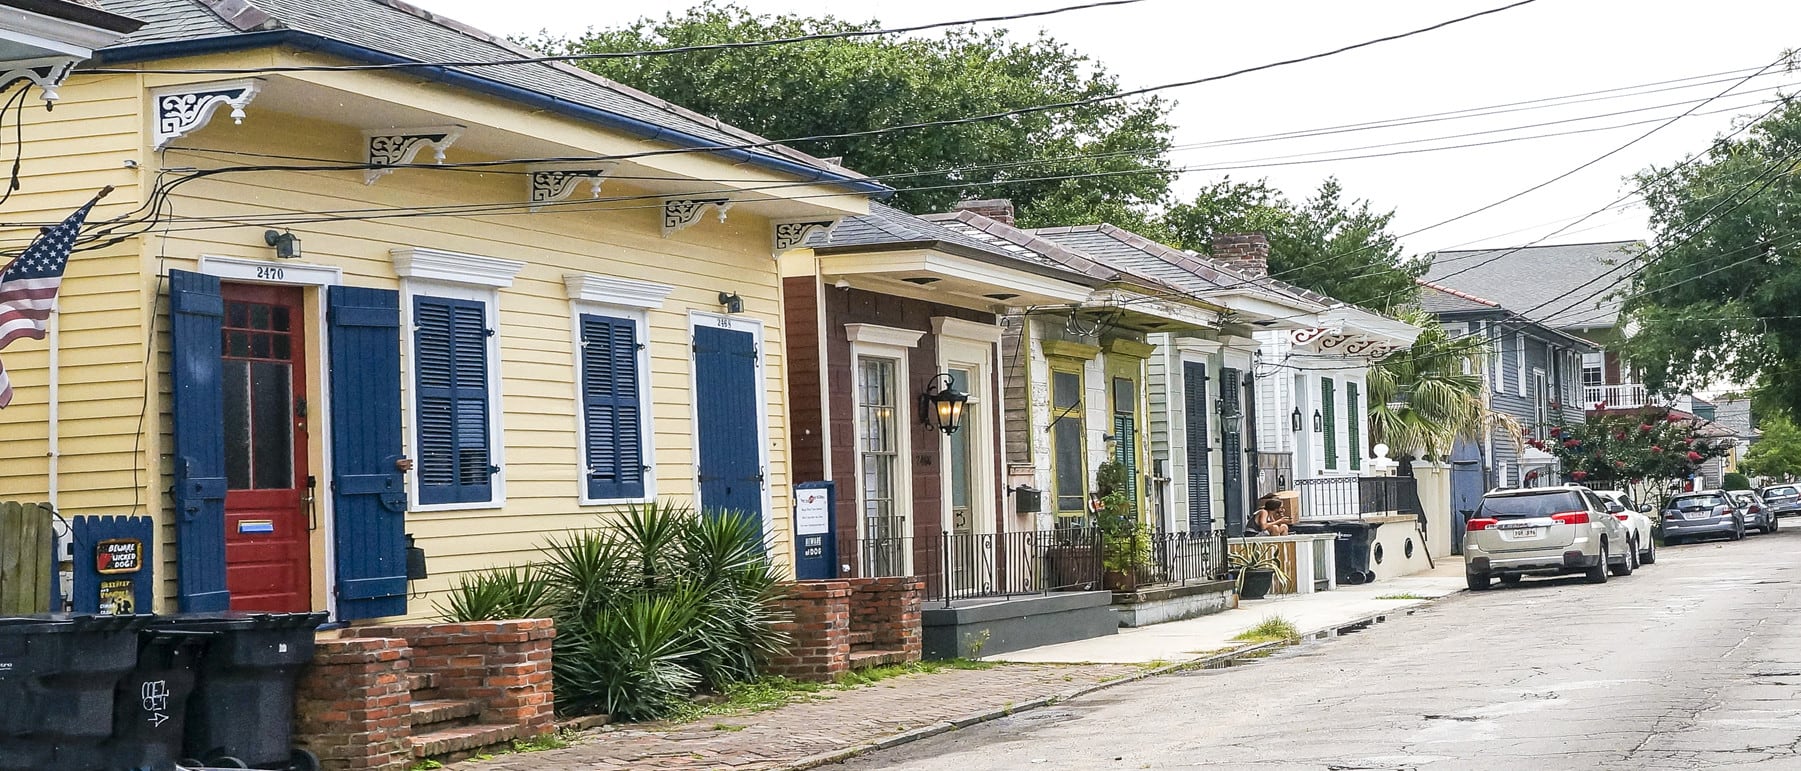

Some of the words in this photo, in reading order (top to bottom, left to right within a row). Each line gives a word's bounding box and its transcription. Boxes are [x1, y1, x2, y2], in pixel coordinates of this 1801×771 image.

[256, 266, 284, 280] 2470
[108, 543, 136, 553] BEWARE
[112, 553, 137, 562] WICKED
